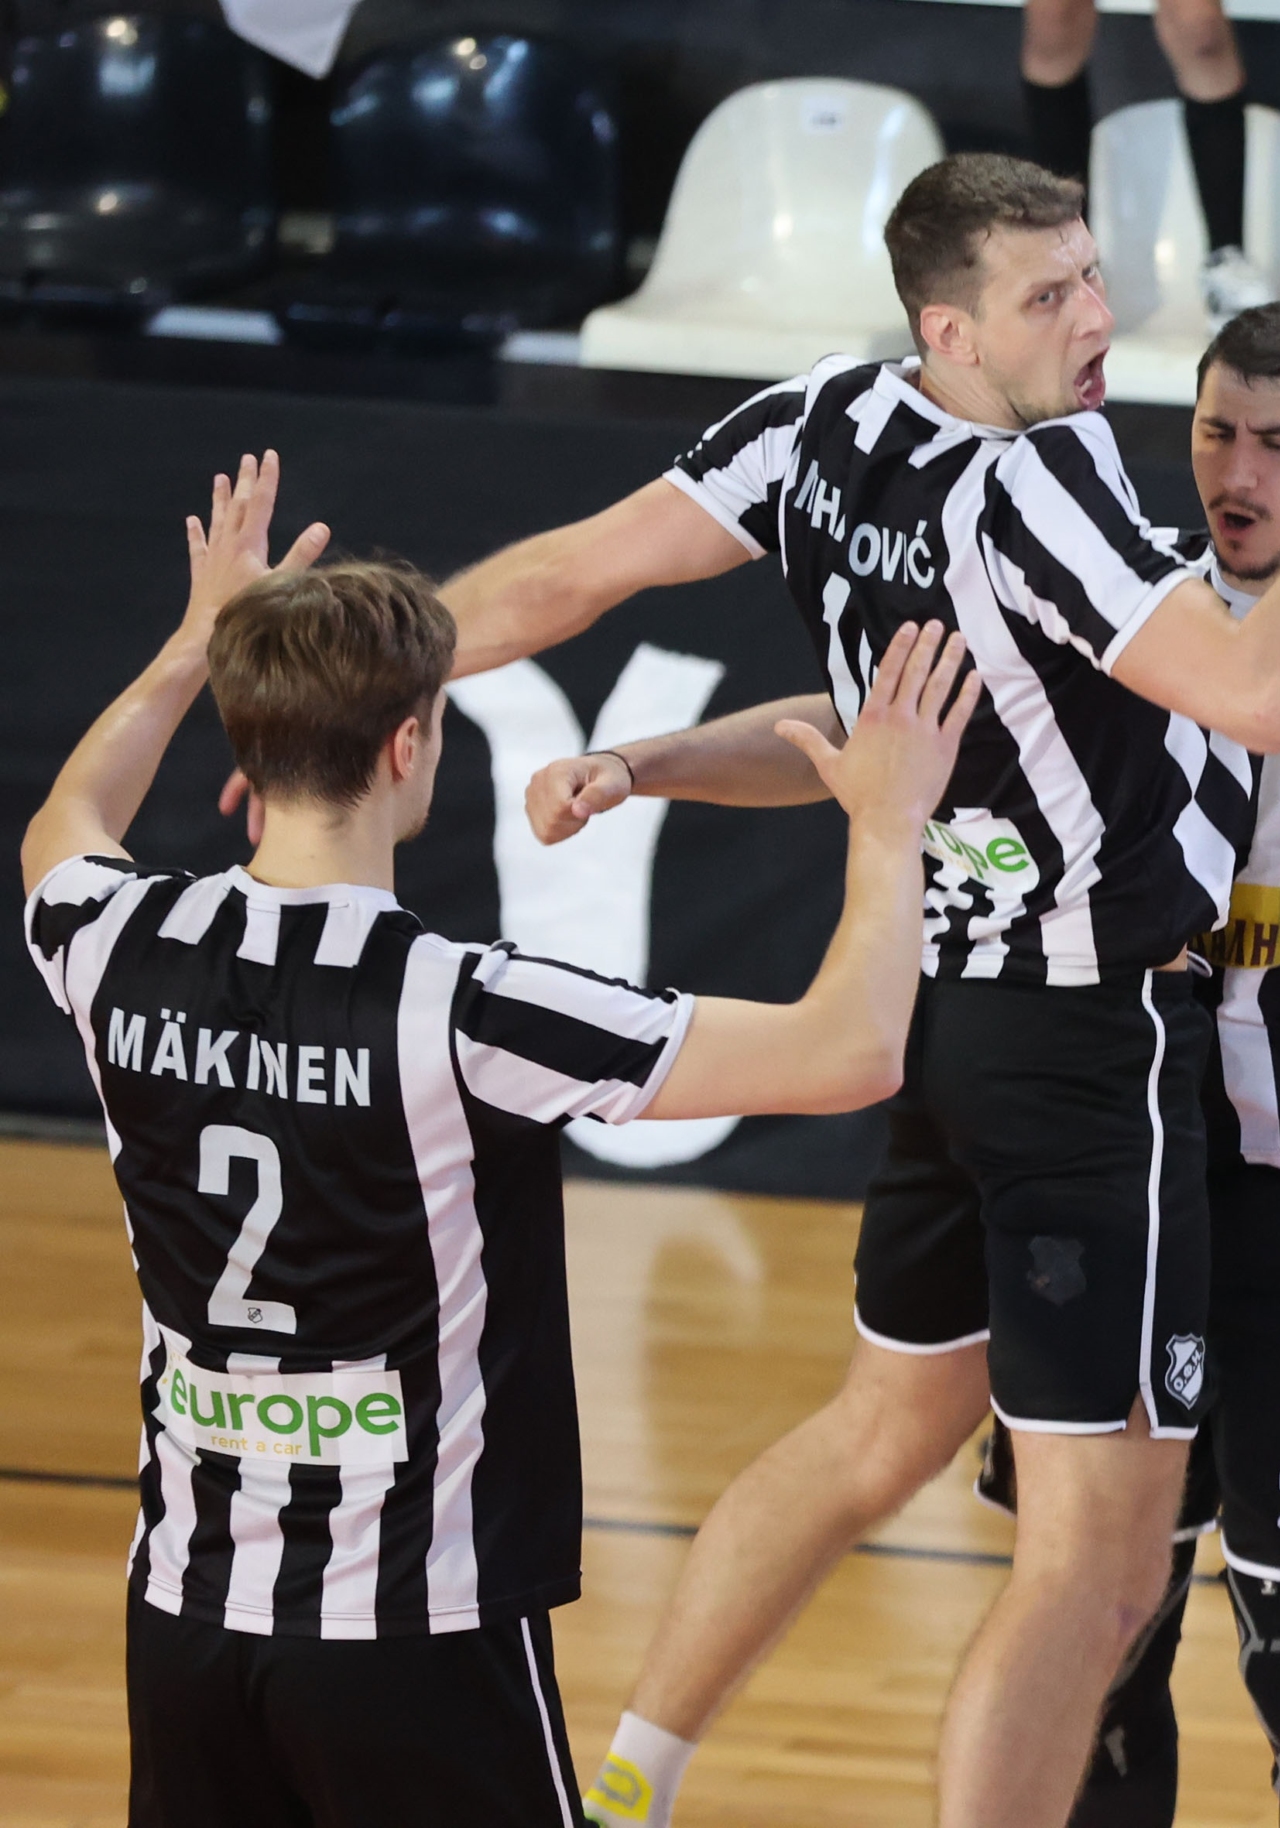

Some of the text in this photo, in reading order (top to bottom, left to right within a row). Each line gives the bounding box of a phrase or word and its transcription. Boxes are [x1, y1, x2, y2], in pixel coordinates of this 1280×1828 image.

[107, 1007, 372, 1108] MÄKINEN
[197, 1124, 297, 1335] 2
[169, 1368, 402, 1457] europe
[210, 1432, 303, 1457] rent a car
